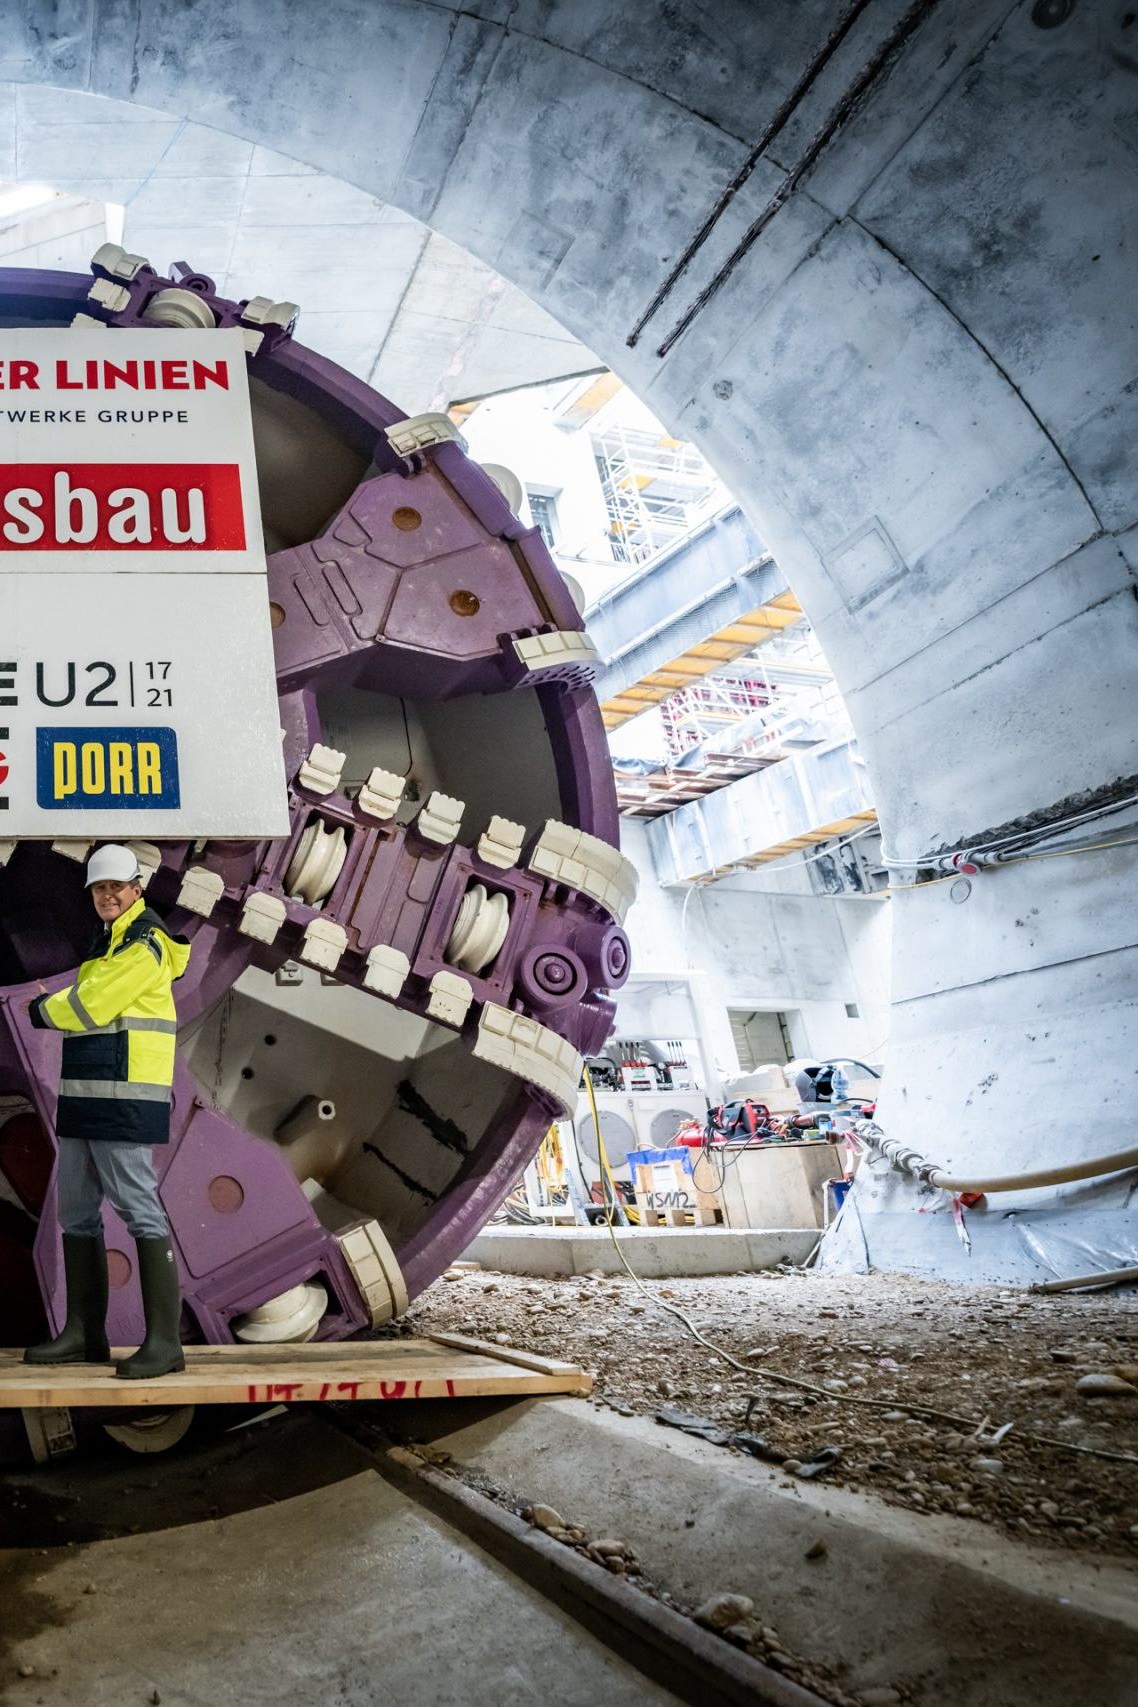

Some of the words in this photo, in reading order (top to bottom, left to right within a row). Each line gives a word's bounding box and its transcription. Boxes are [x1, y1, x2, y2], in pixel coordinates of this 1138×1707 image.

[55, 359, 230, 392] LINIEN
[97, 410, 189, 424] GRUPPE
[36, 661, 119, 707] U2
[145, 661, 172, 680] 17
[147, 688, 173, 707] 21
[53, 742, 163, 800] PORR
